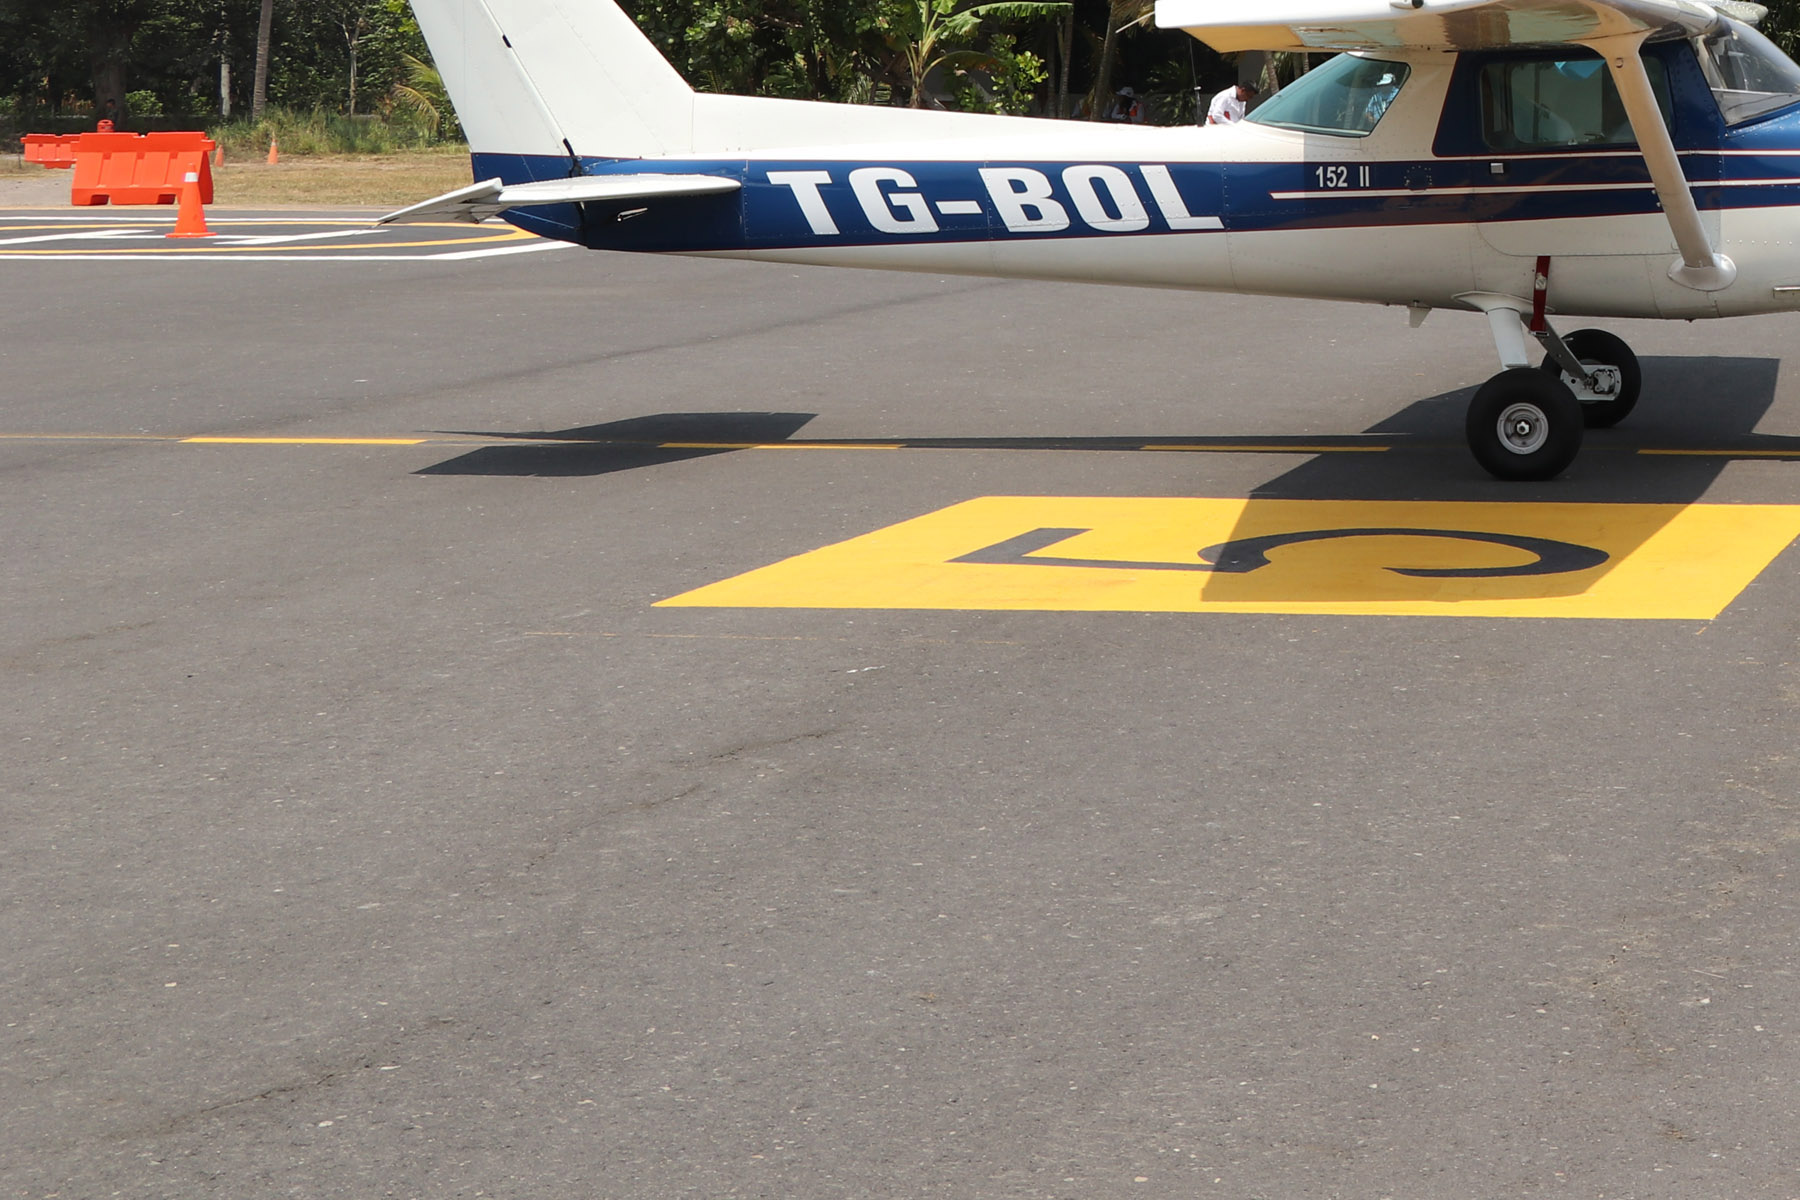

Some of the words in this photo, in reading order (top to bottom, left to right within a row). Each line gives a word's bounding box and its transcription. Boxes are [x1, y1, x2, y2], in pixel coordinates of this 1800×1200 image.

[765, 163, 1226, 236] TG-BOL
[1315, 165, 1349, 188] 152
[945, 527, 1610, 578] 5
